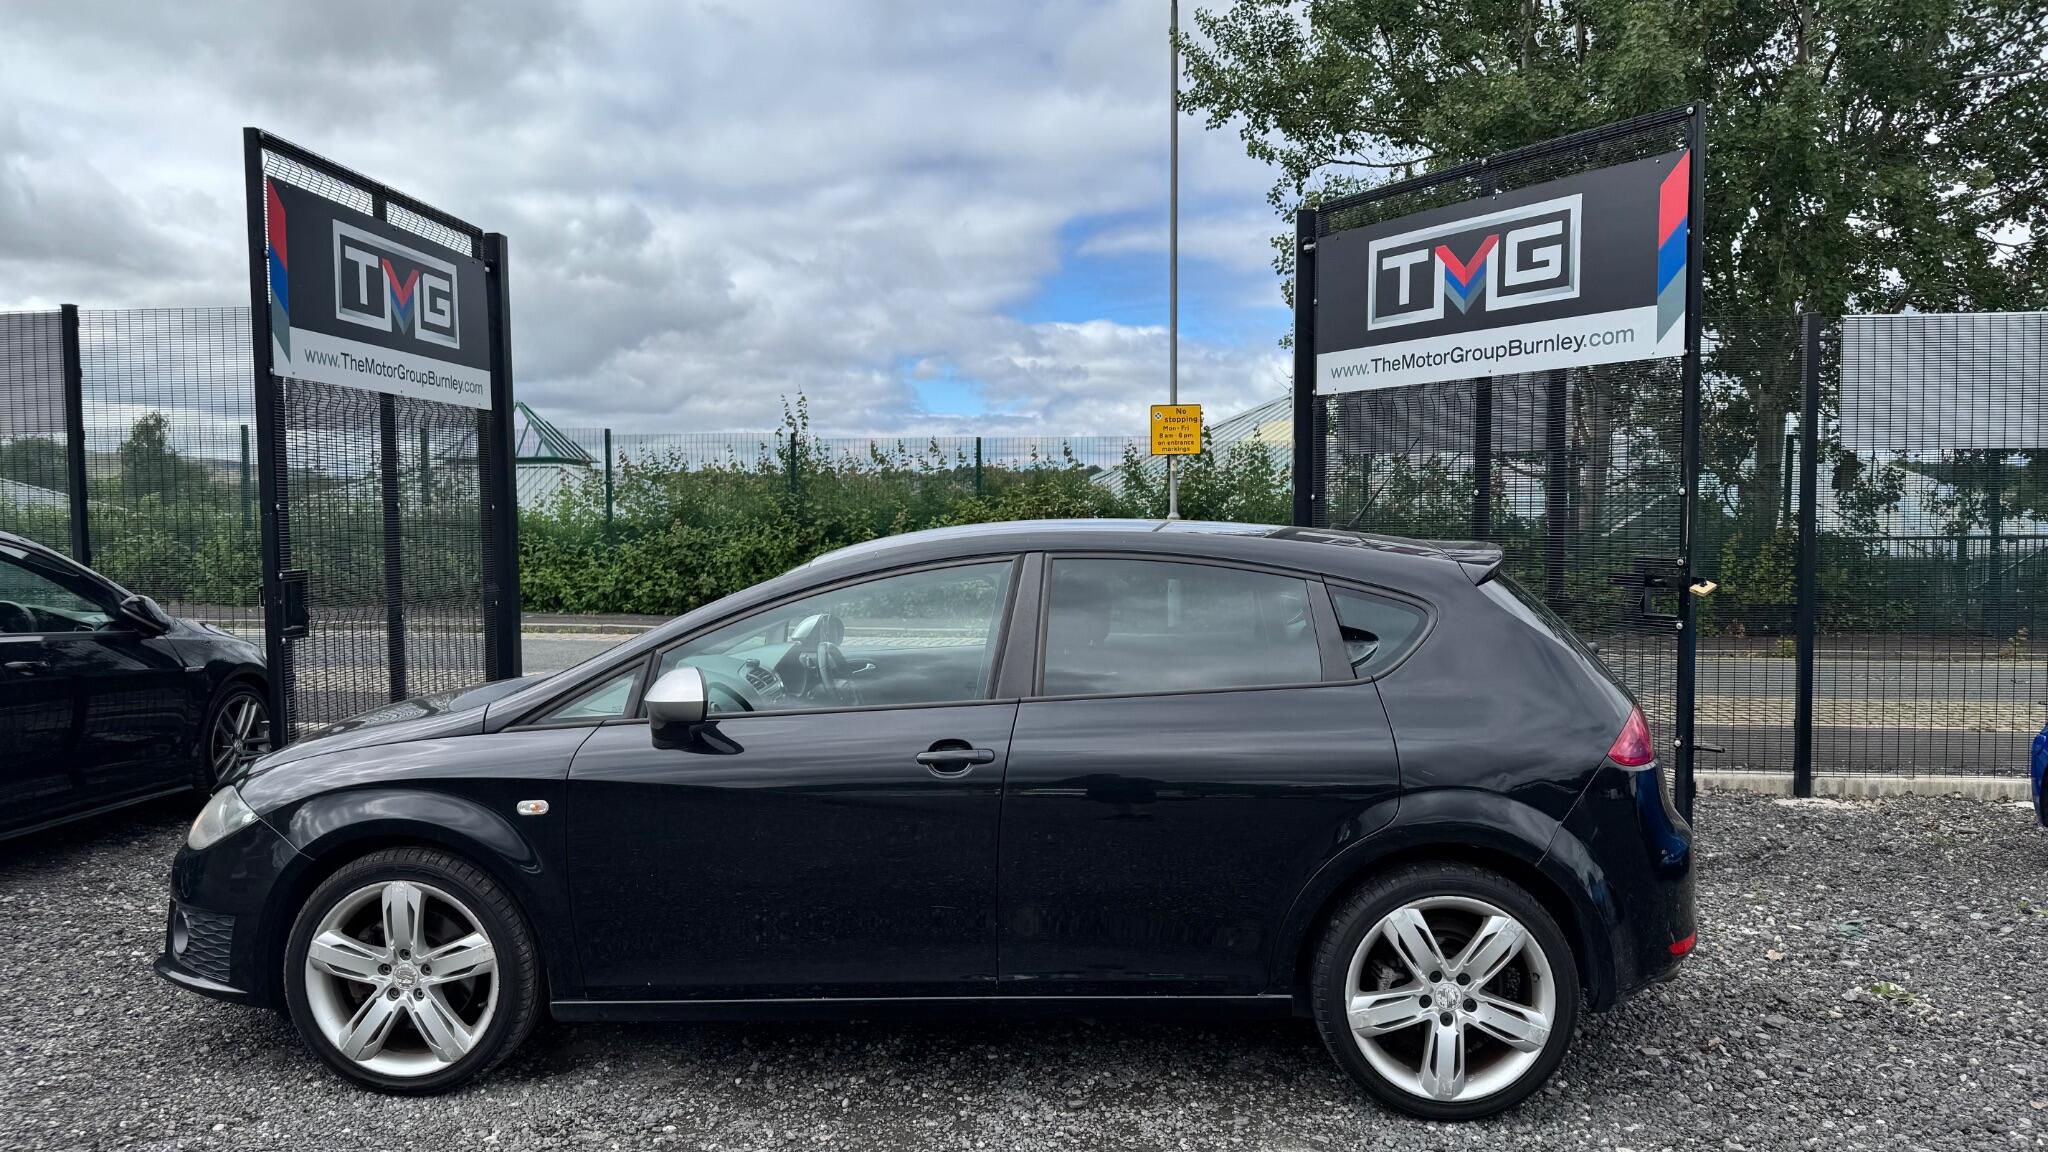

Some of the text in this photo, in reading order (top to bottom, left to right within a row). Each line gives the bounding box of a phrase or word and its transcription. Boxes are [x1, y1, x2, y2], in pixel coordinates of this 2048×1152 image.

[345, 245, 450, 338] TMG
[1382, 220, 1563, 318] TMG
[304, 349, 483, 395] www.TheMotorGroupBurnley.com
[1331, 328, 1635, 378] www.TheMotorGroupBurnley.com
